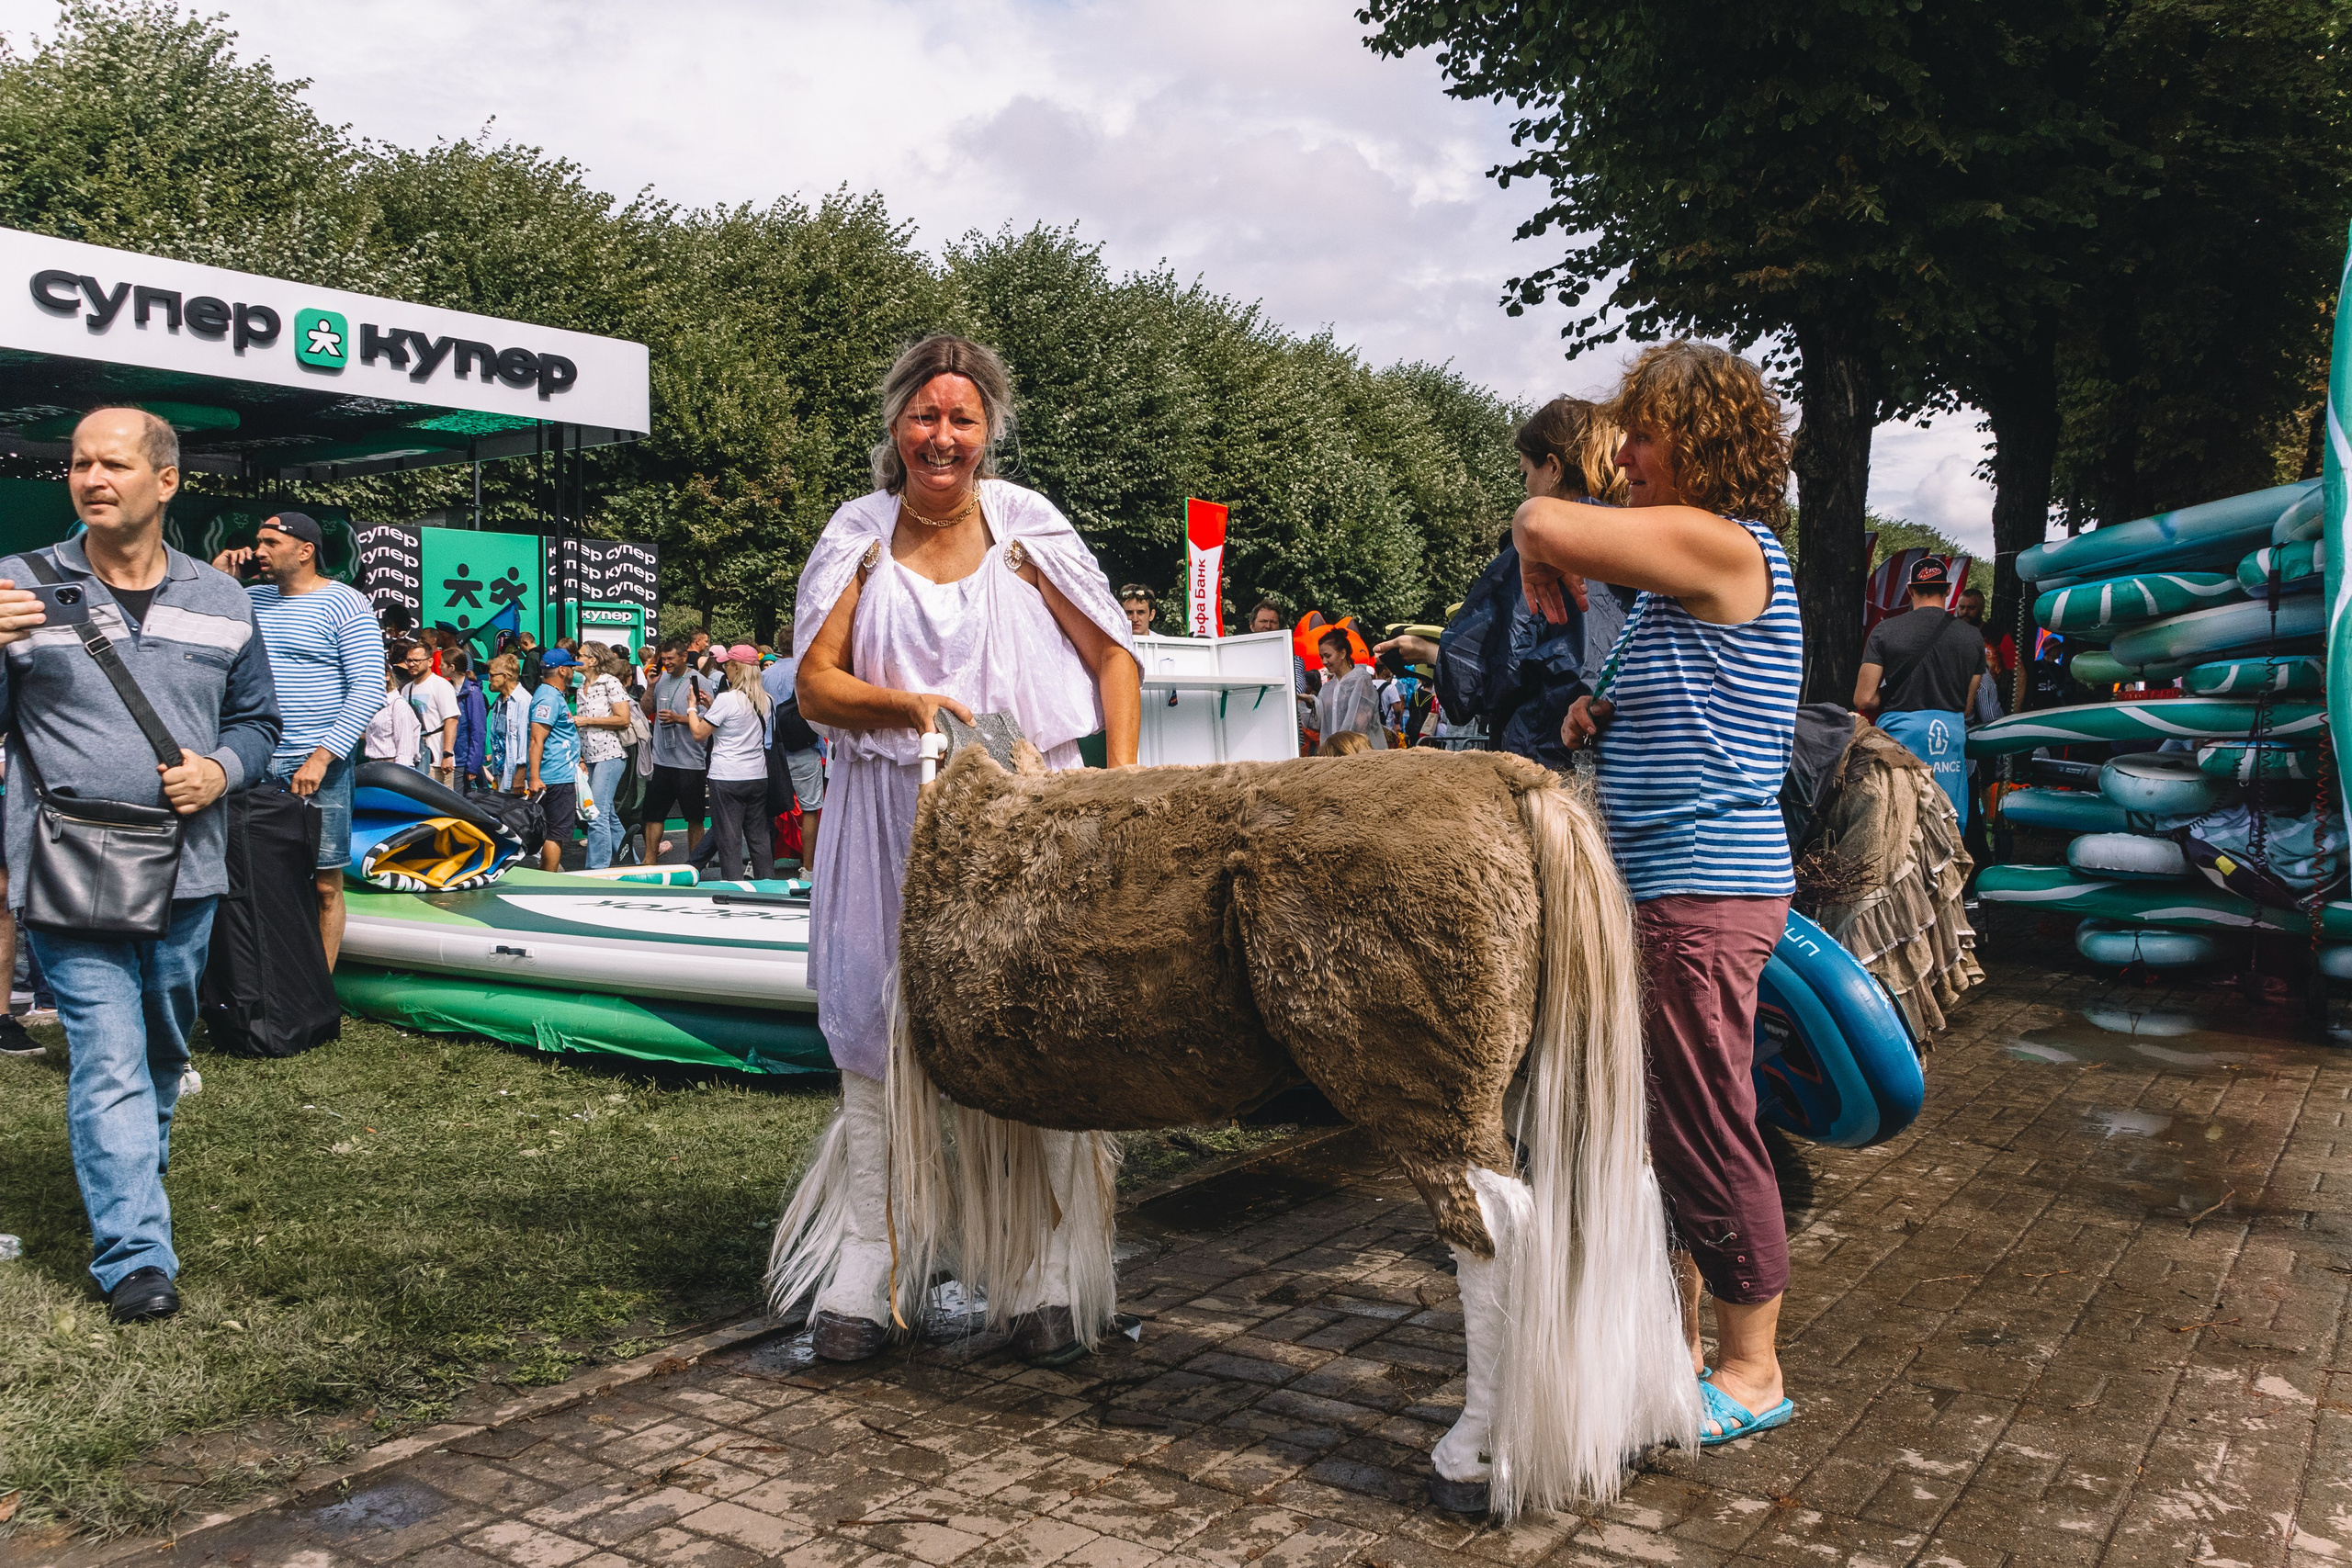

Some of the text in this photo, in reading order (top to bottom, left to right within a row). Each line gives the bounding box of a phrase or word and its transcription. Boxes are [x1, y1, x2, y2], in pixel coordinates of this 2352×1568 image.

[29, 269, 578, 395] супер купер
[357, 525, 419, 547] супер
[548, 540, 656, 565] кпер супер
[366, 567, 419, 588] упер
[548, 559, 657, 583] спер купер
[368, 588, 420, 608] упер
[548, 578, 657, 602] кпер супер
[1194, 558, 1209, 634] ьфа Банк
[582, 610, 632, 623] купер
[1925, 761, 1962, 773] ANCE
